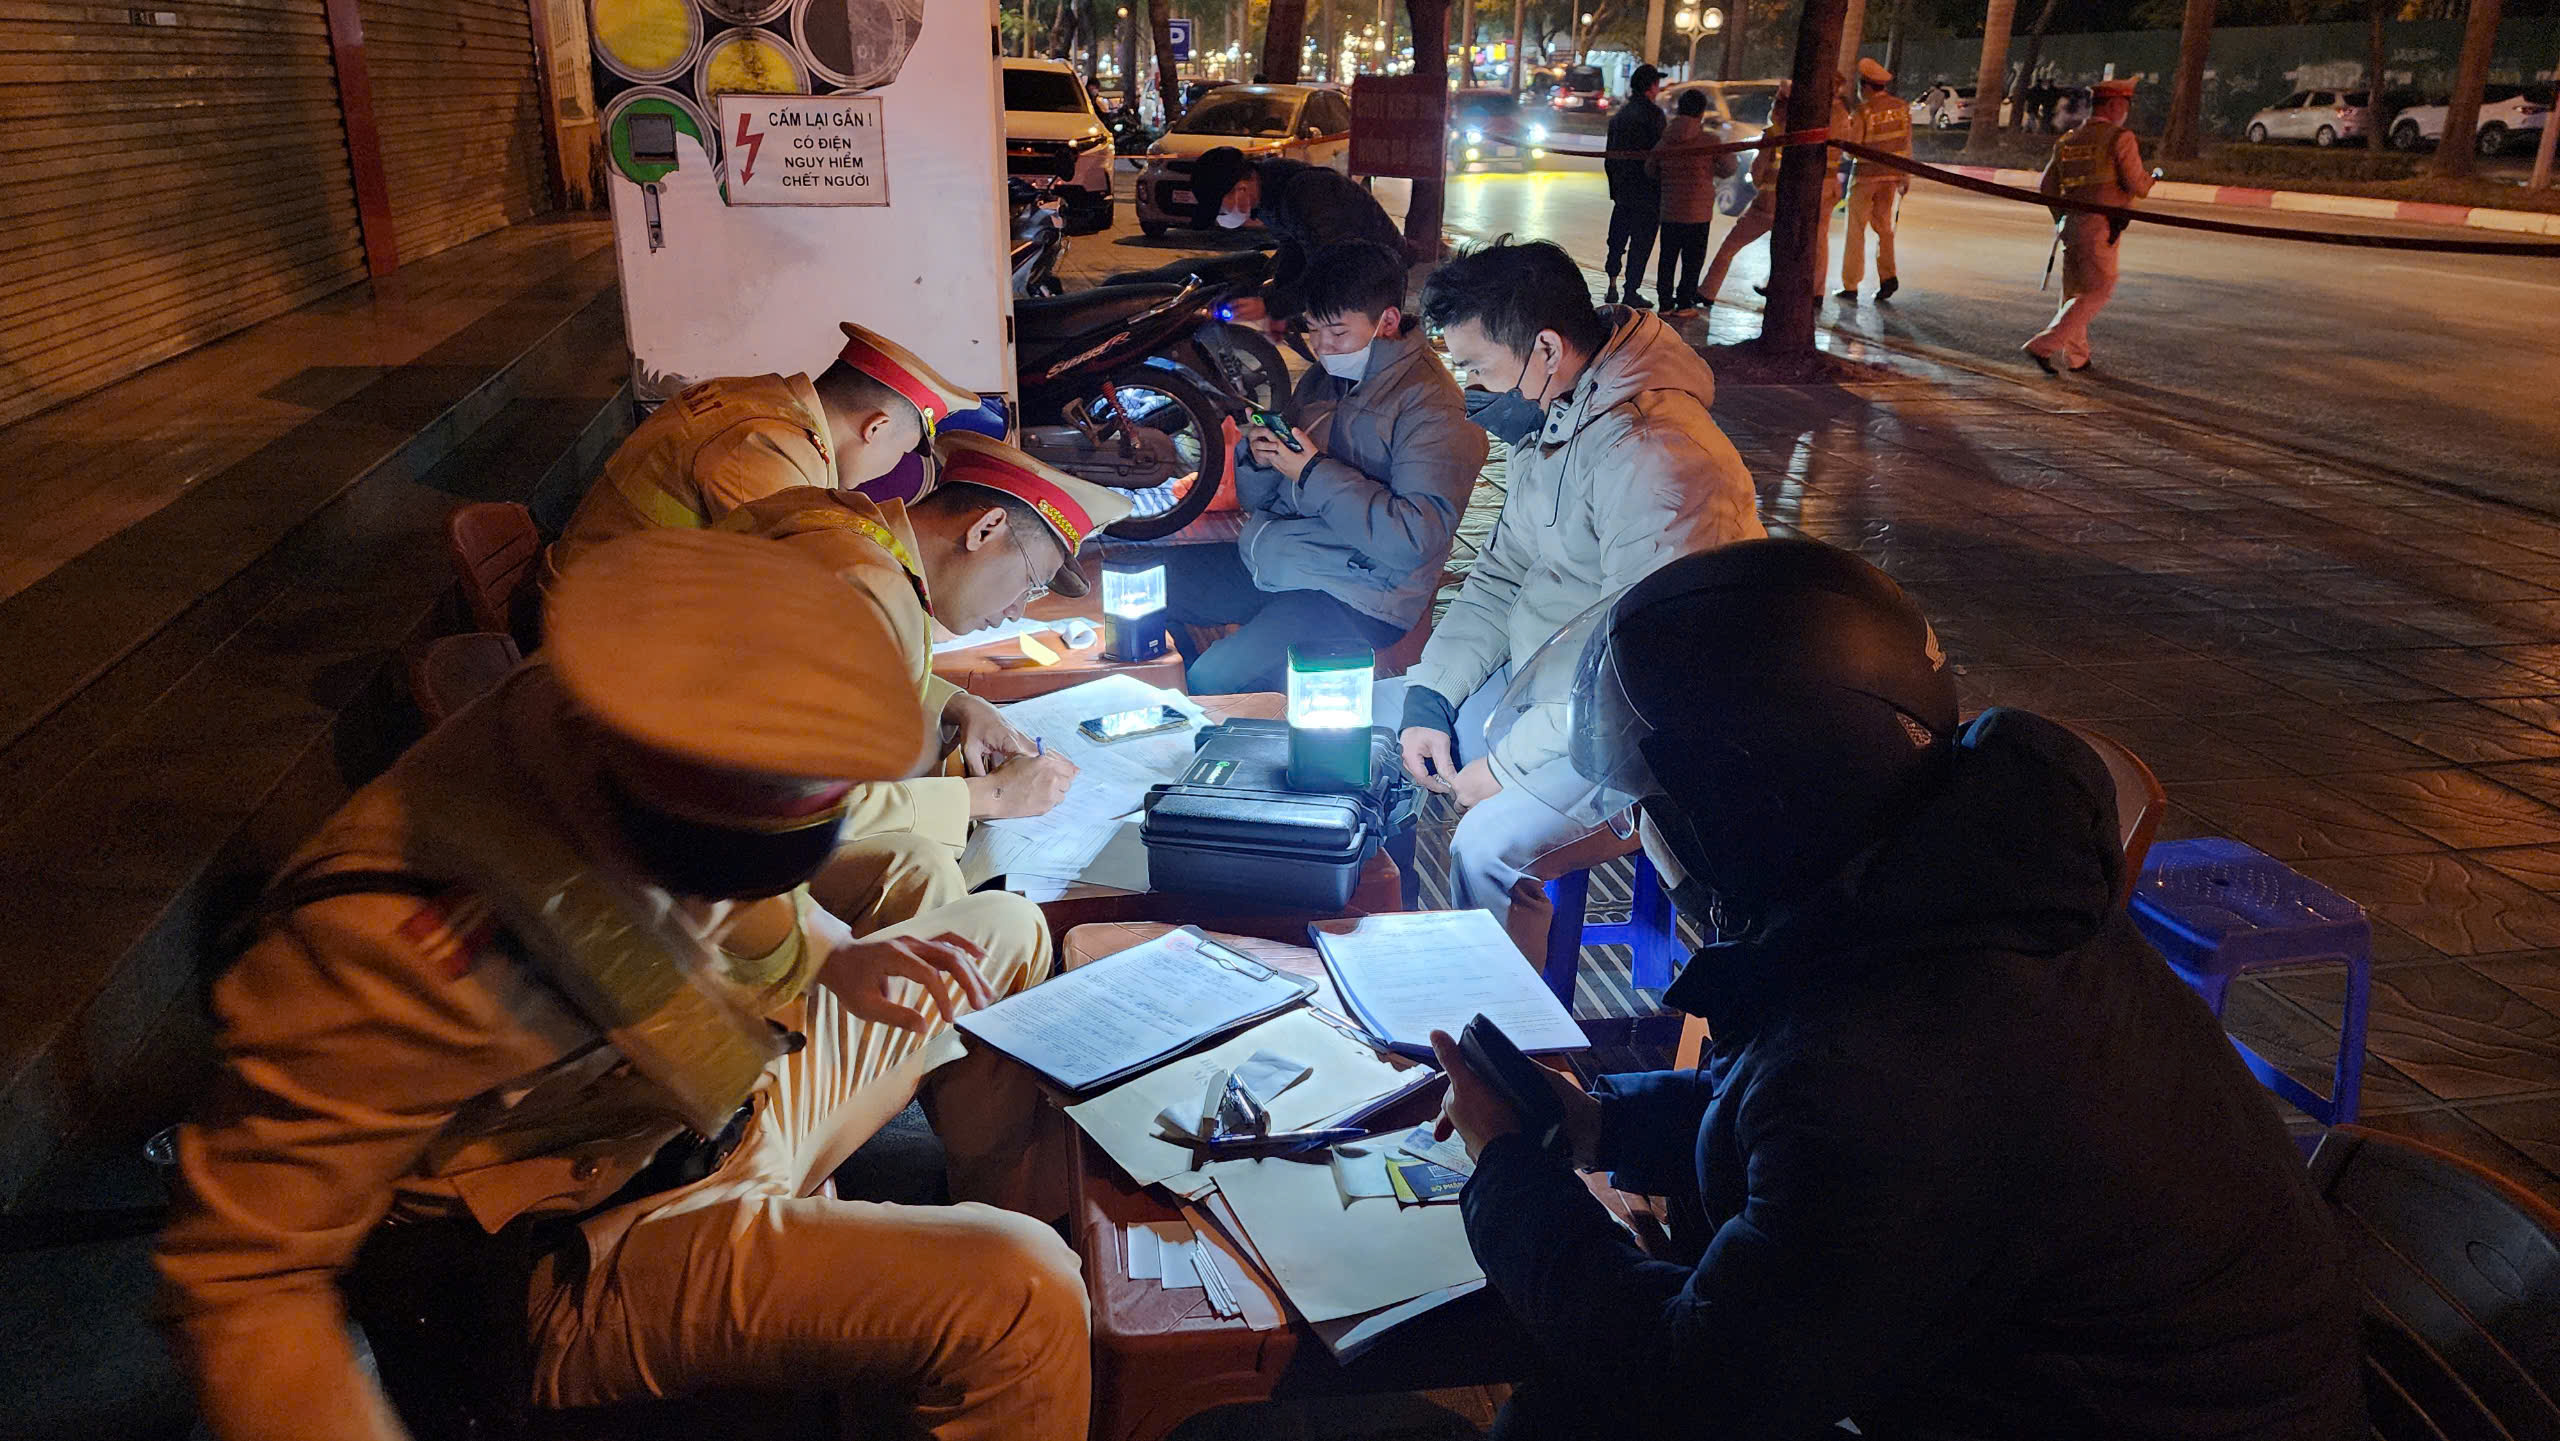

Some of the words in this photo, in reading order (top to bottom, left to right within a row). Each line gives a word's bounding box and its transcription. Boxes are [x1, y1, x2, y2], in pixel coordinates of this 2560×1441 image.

[1170, 27, 1185, 44] P
[769, 107, 800, 127] CẤM
[806, 112, 828, 130] LẠI
[833, 107, 864, 127] GẦN
[793, 135, 813, 149] CÓ
[818, 136, 851, 151] ĐIỆN
[785, 157, 824, 168] NGUY
[829, 152, 863, 168] HIỂM
[782, 172, 819, 187] CHẾT
[825, 172, 869, 187] NGƯỜI
